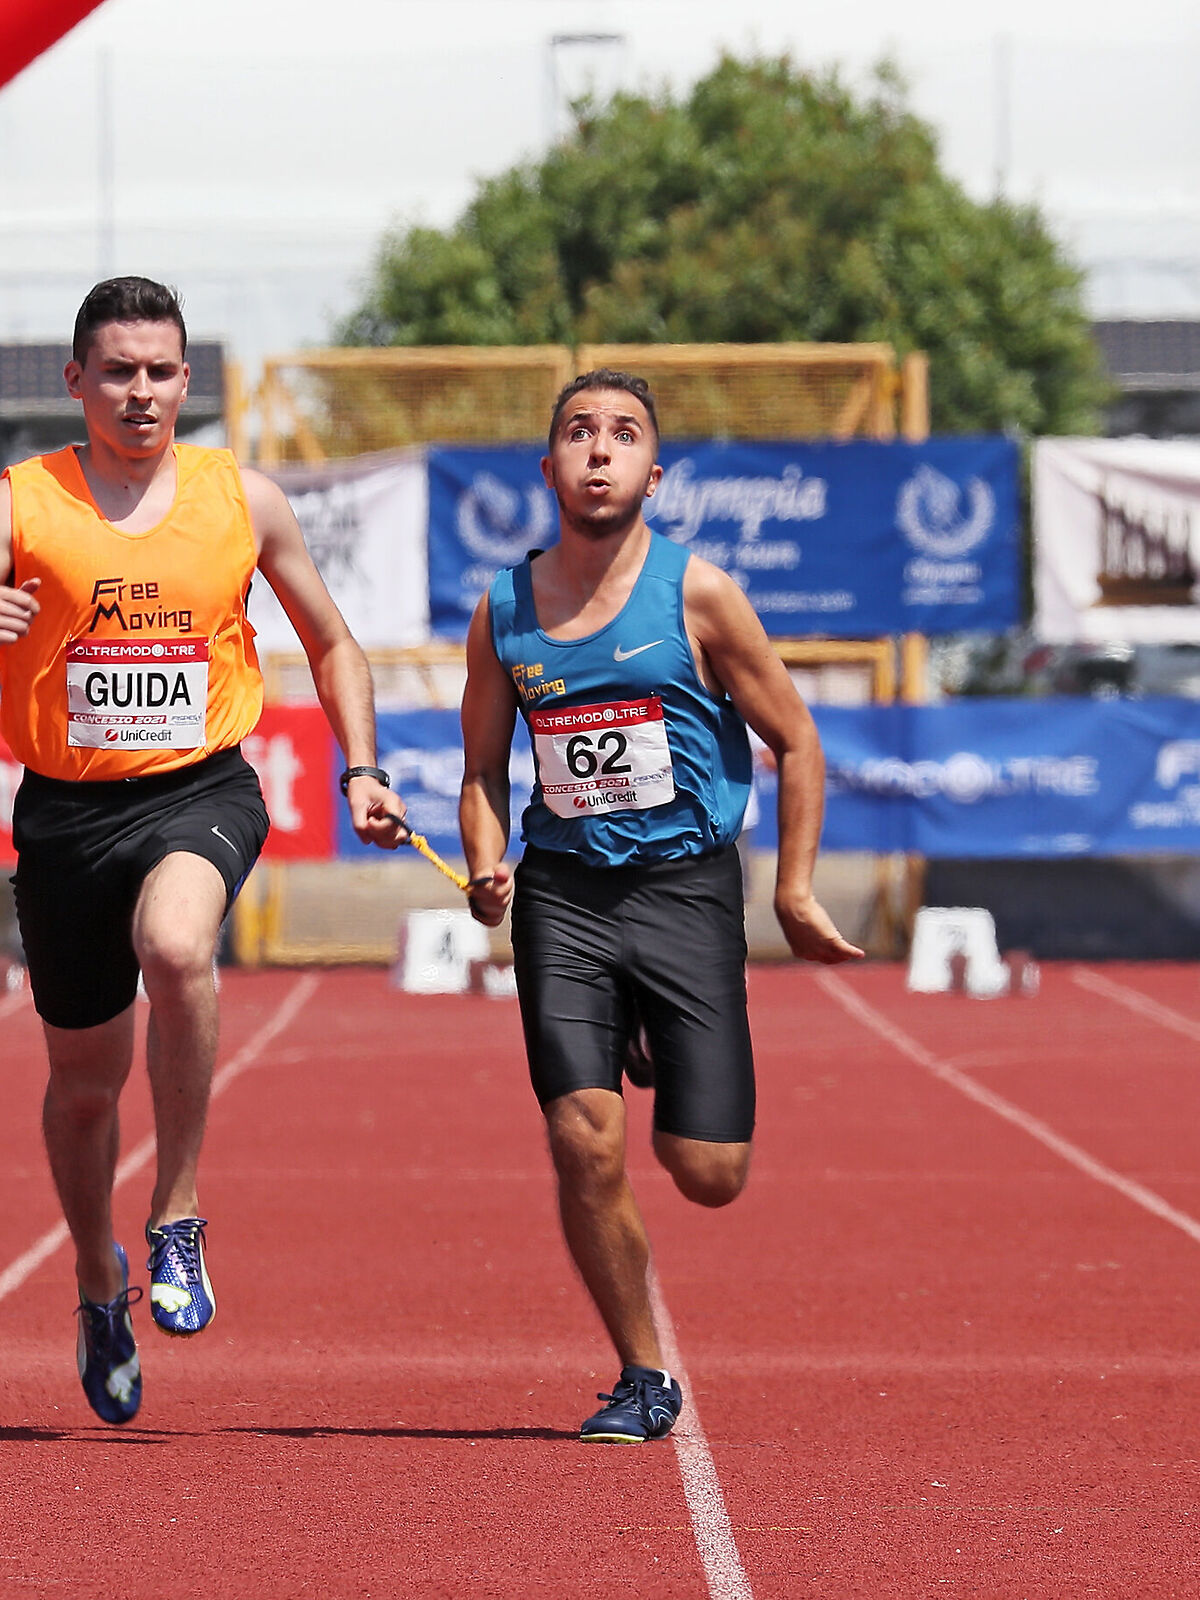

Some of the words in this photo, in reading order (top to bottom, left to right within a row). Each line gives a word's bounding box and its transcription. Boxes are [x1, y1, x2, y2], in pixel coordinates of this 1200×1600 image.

[91, 577, 159, 605] Free
[89, 600, 192, 633] Moving
[512, 663, 544, 683] Free
[85, 672, 191, 708] GUIDA
[517, 679, 566, 701] Moving
[73, 714, 133, 724] CONCESIO
[135, 716, 165, 724] 2021
[120, 729, 172, 741] UniCredit
[566, 731, 631, 778] 62
[544, 781, 597, 794] CONCESIO
[599, 778, 627, 788] 2021
[587, 790, 638, 807] UniCredit
